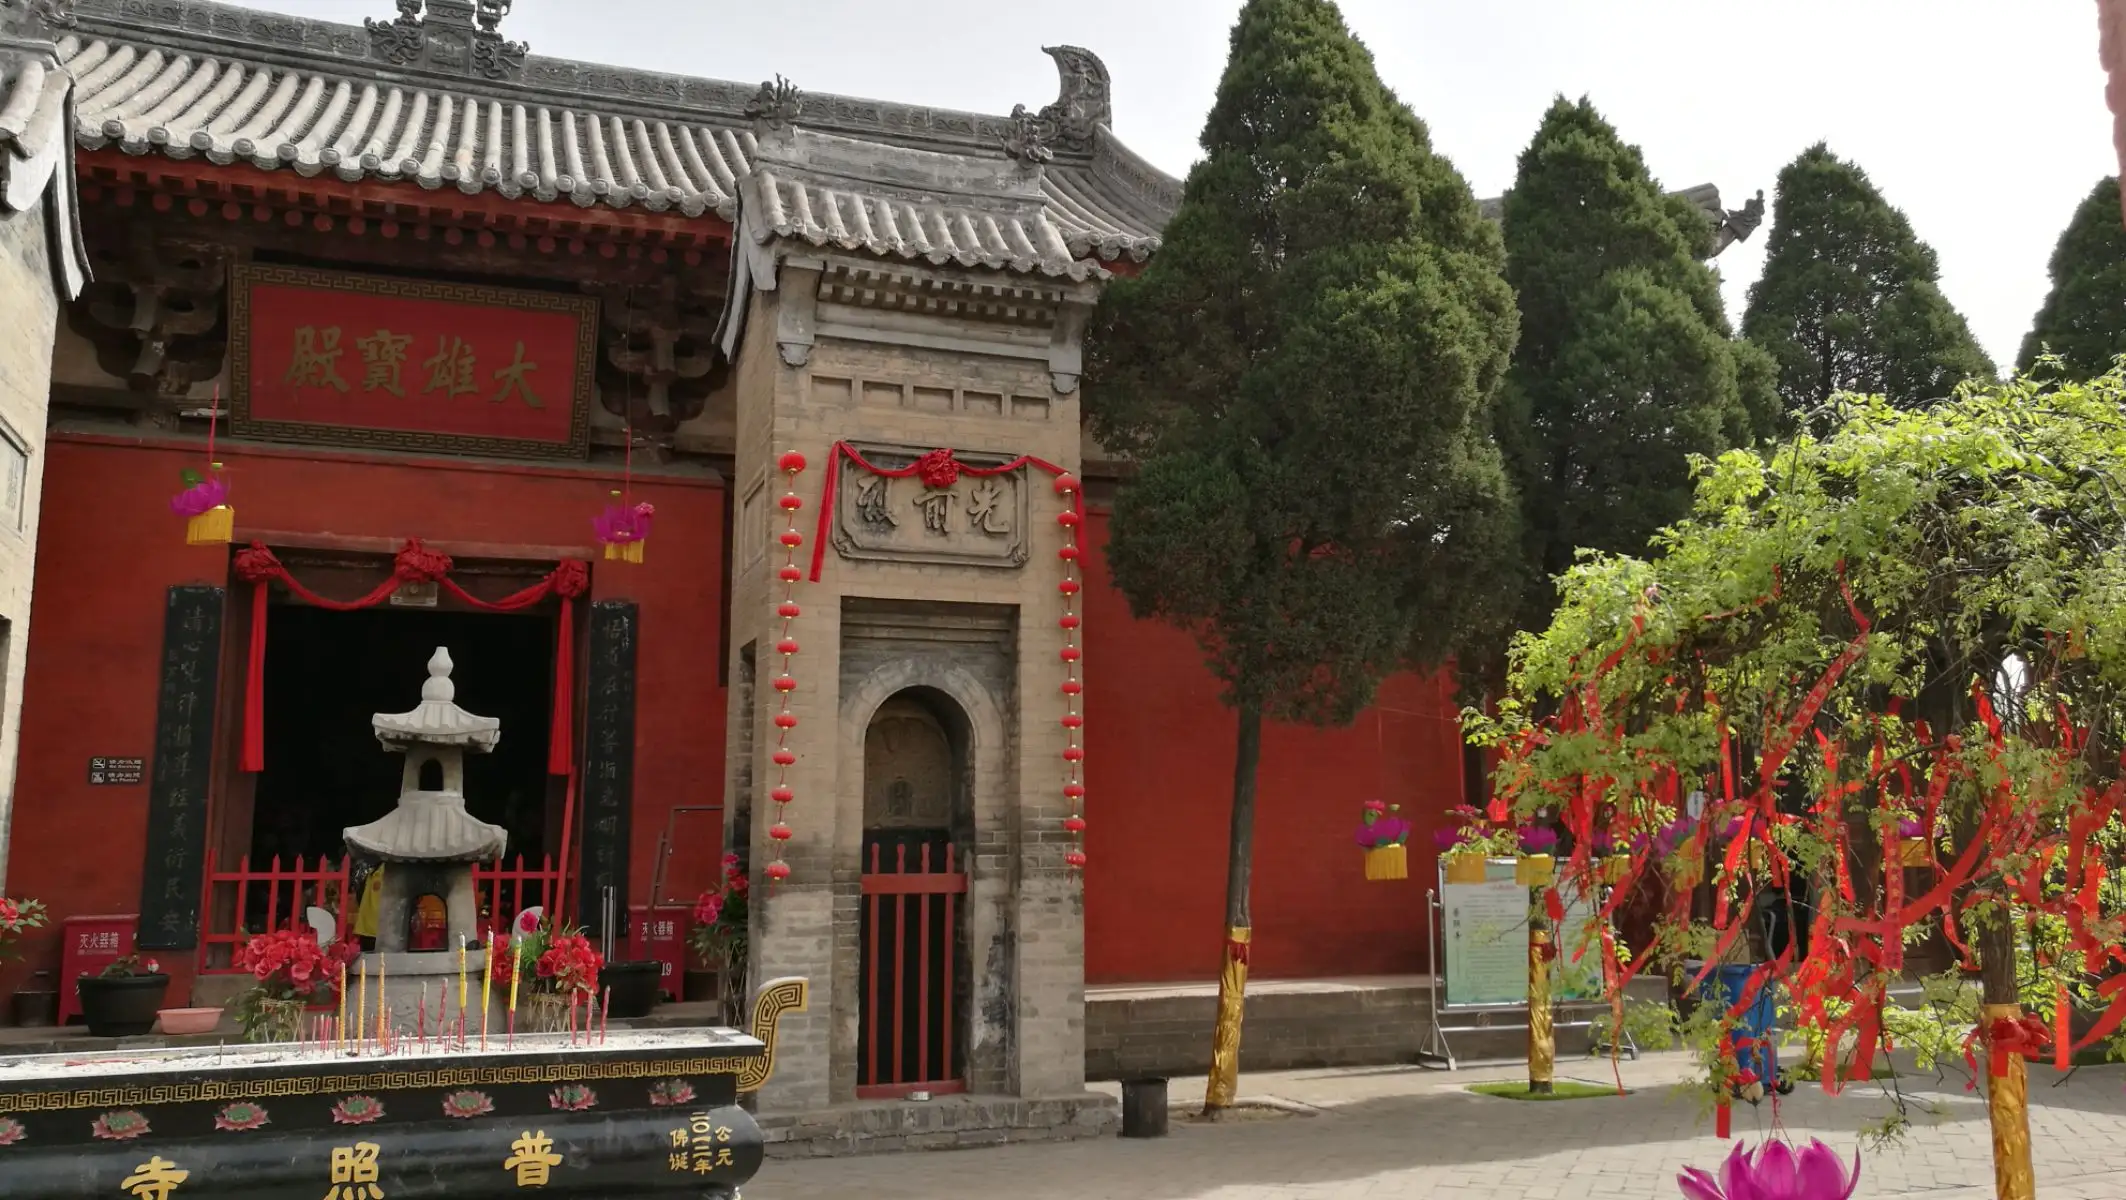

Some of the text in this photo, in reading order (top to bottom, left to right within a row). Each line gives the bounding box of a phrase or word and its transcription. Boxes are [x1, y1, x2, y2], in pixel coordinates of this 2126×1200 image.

[284, 324, 545, 410] 大雄寶殿
[79, 932, 119, 949] 灭火器箱
[715, 1125, 734, 1166] 公元
